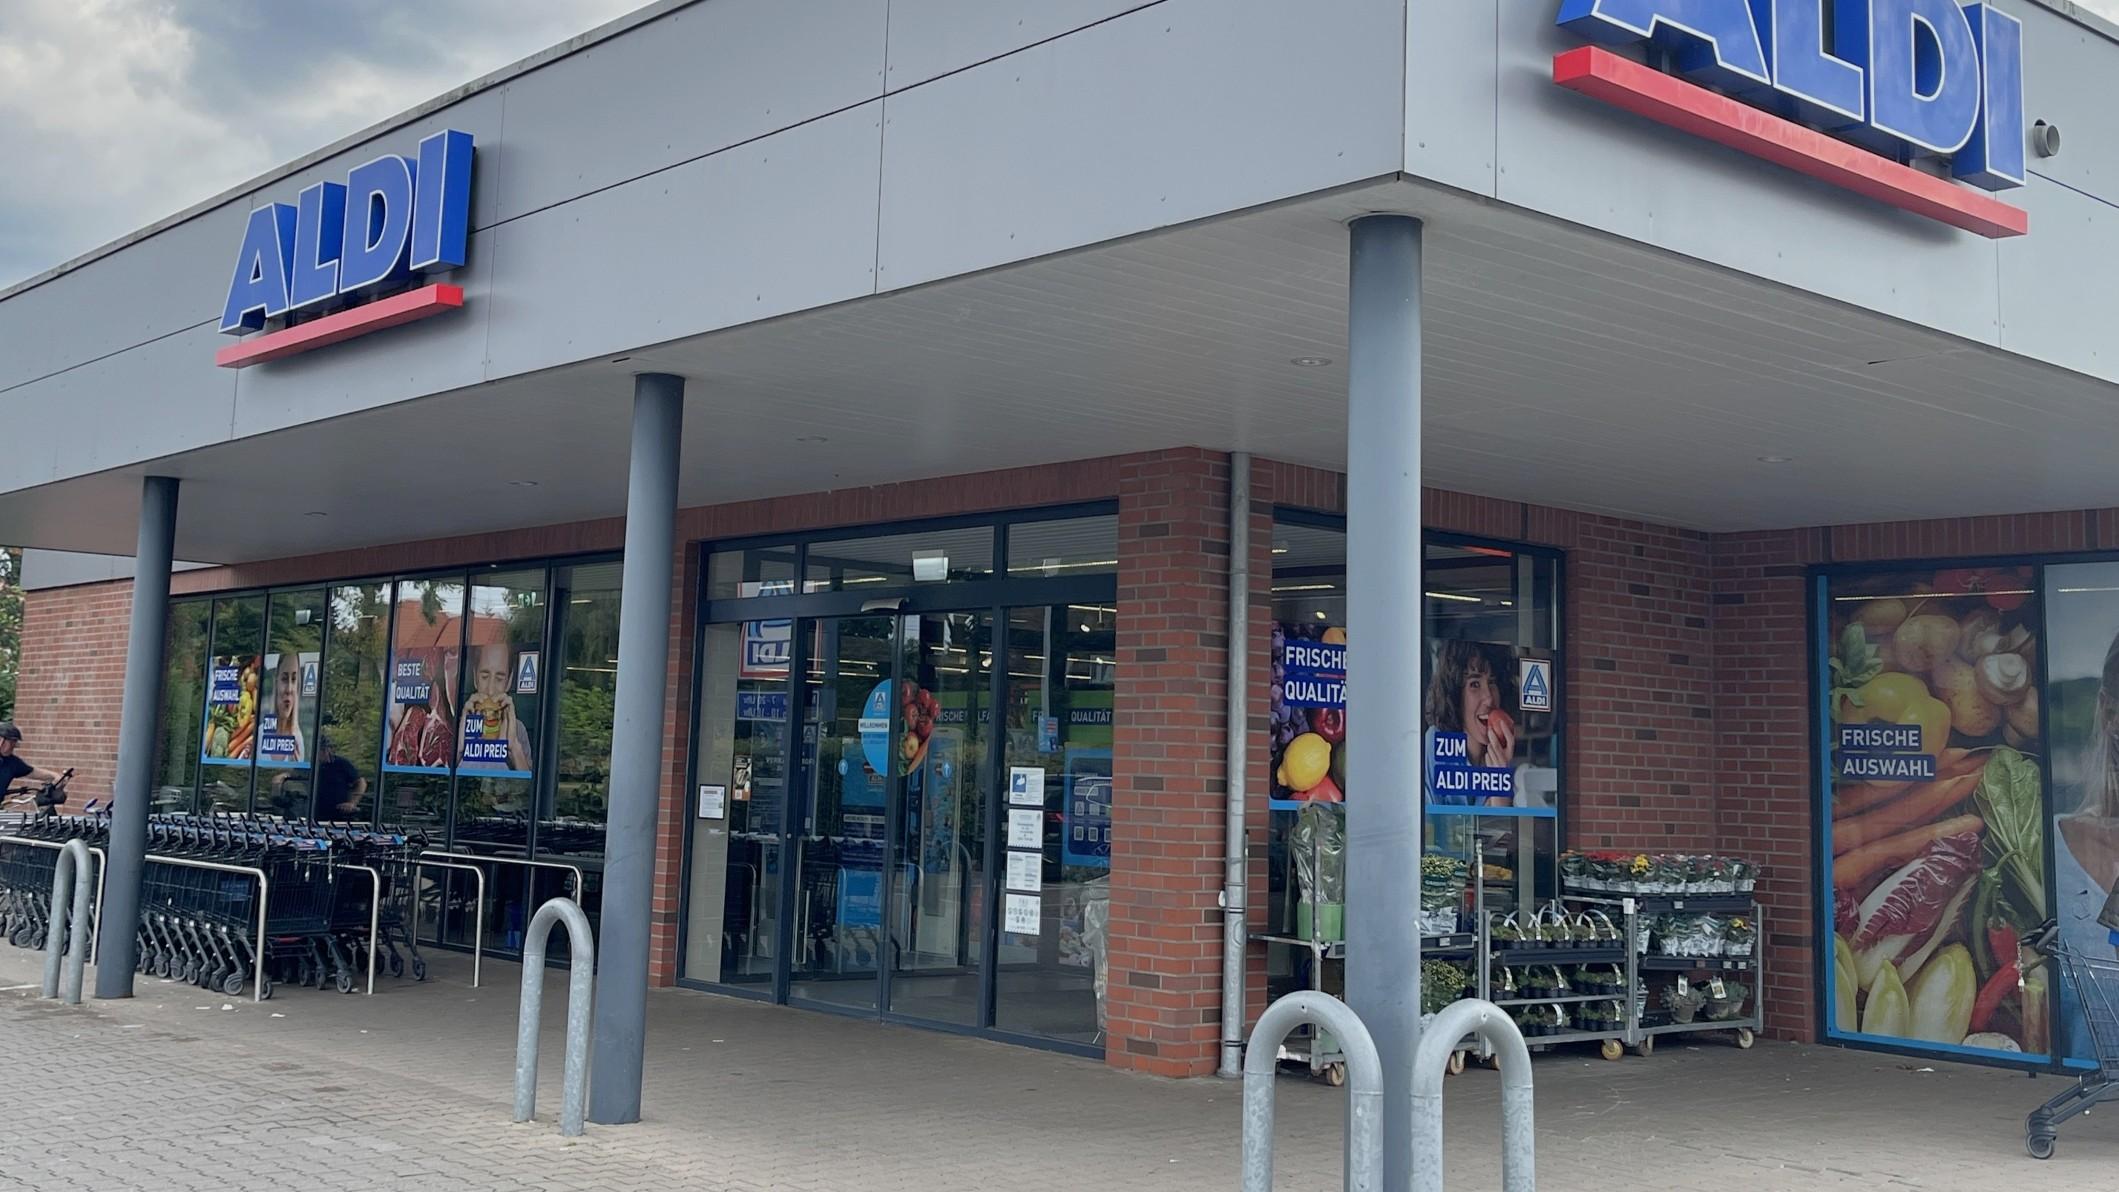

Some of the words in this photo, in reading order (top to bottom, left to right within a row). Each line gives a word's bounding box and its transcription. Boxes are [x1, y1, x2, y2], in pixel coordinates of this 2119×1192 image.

[1556, 0, 2026, 190] LDI
[219, 129, 473, 335] ALDI
[215, 669, 238, 681] FRISCHE
[397, 663, 420, 676] BESTE
[213, 689, 239, 701] AUSWAHL
[396, 683, 430, 699] QUALITÄT
[1285, 680, 1347, 703] QUALITÄ
[1525, 695, 1546, 705] ALDI
[936, 710, 964, 721] RISCHE
[1071, 708, 1111, 722] QUALITÄT
[263, 717, 277, 730] ZUM
[465, 719, 483, 733] ZUM
[262, 738, 276, 751] ALDI
[277, 739, 294, 751] PREIS
[1842, 729, 1919, 746] FRISCHE
[464, 743, 482, 757] ALDI
[484, 743, 508, 758] PREIS
[1436, 737, 1466, 757] ZUM
[1843, 758, 1935, 776] AUSWAHL
[1436, 772, 1469, 790] ALDI
[1472, 773, 1511, 791] PREIS
